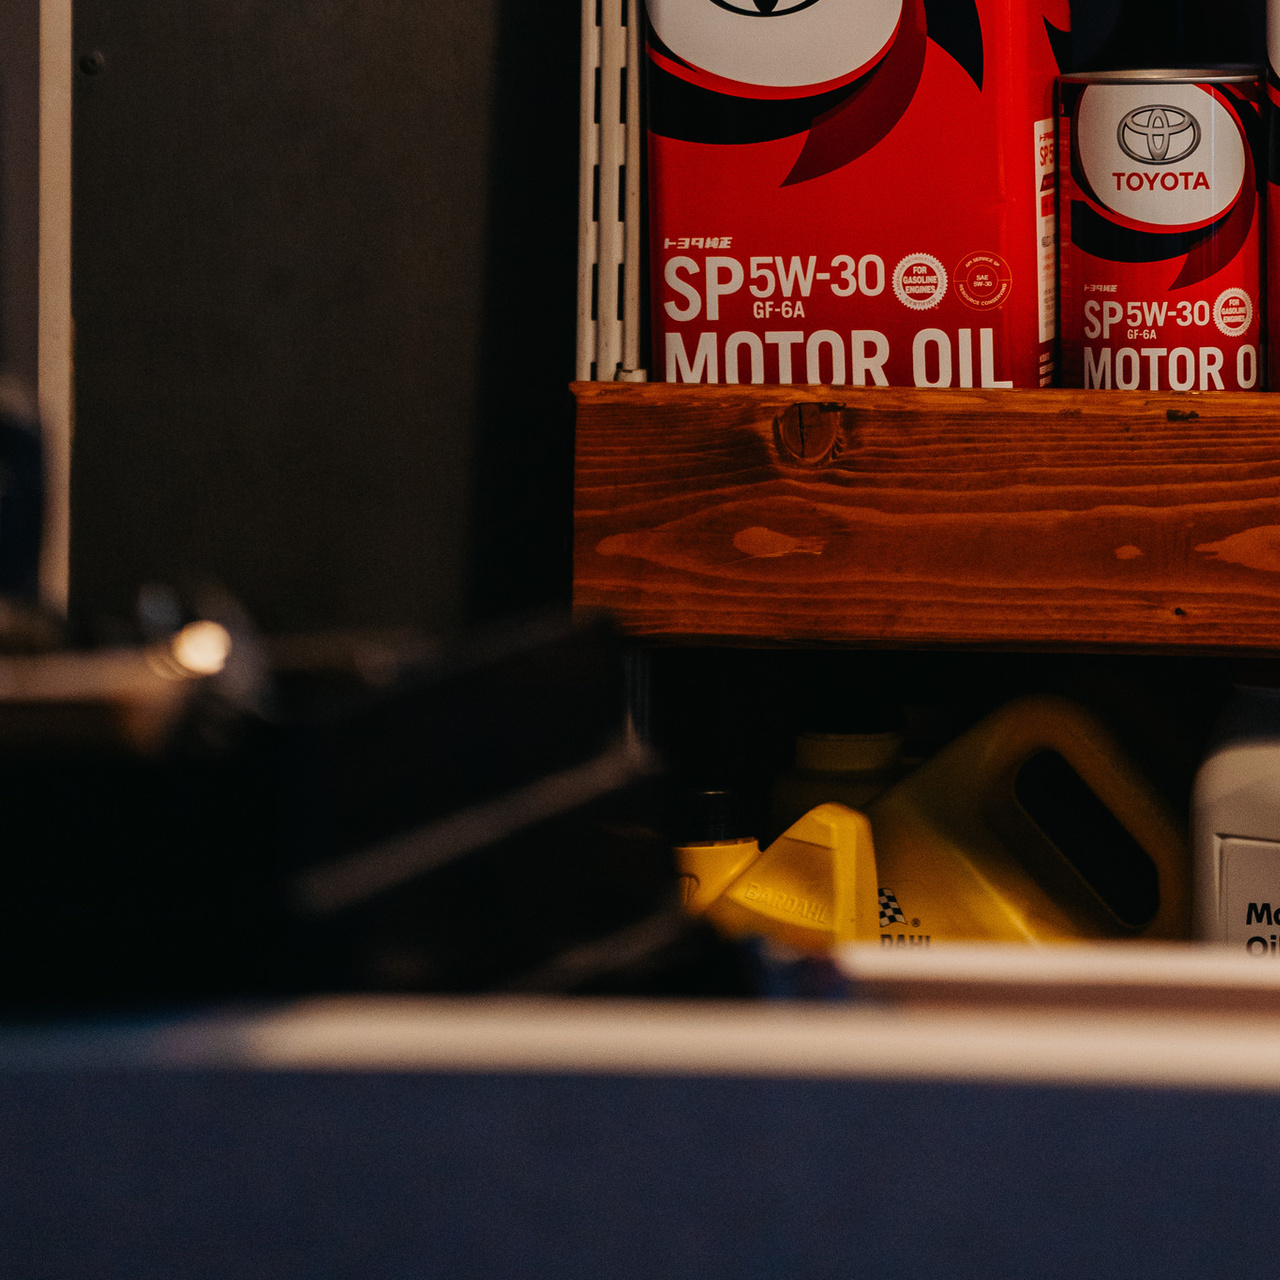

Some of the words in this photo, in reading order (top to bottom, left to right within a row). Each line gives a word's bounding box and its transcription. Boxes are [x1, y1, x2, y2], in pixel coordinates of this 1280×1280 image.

[1113, 172, 1210, 191] TOYOTA
[664, 255, 744, 322] SP
[750, 254, 885, 298] 5W-30
[753, 300, 805, 318] GF-6A
[1084, 300, 1123, 340] SP
[1127, 301, 1210, 327] 5W-30
[1127, 329, 1157, 339] GF-6A
[665, 329, 889, 387] MOTOR
[912, 327, 1013, 389] OIL
[1084, 346, 1225, 391] MOTOR
